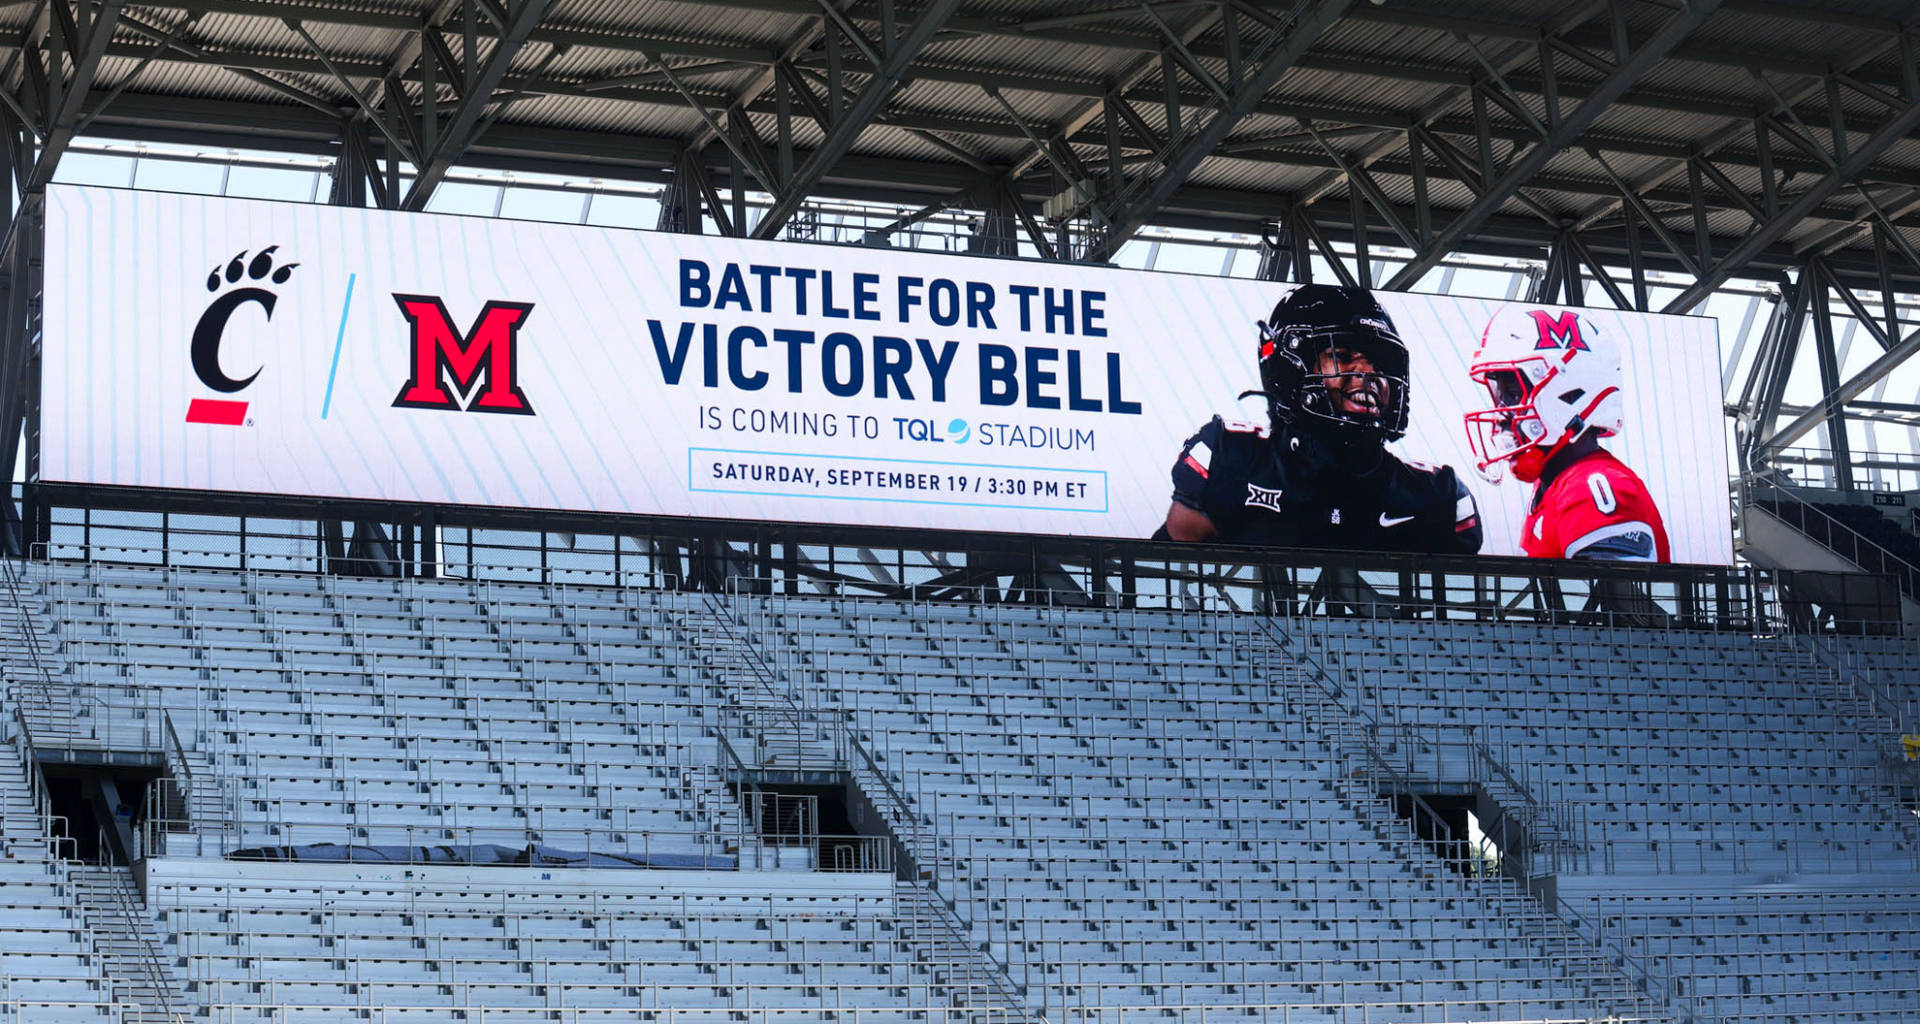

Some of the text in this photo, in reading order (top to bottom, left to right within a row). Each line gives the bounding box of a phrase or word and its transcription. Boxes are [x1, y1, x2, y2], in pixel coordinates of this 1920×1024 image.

[679, 258, 1108, 338] BATTLE FOR THE
[190, 286, 278, 394] C
[391, 292, 537, 416] M
[1525, 309, 1592, 352] M
[646, 319, 1143, 416] VICTORY BELL
[699, 405, 1095, 452] IS COMING TO TQL STADIUM
[712, 462, 1087, 499] SATURDAY, SEPTEMBER 19 / 3:30 PM ET
[1587, 472, 1618, 515] 0
